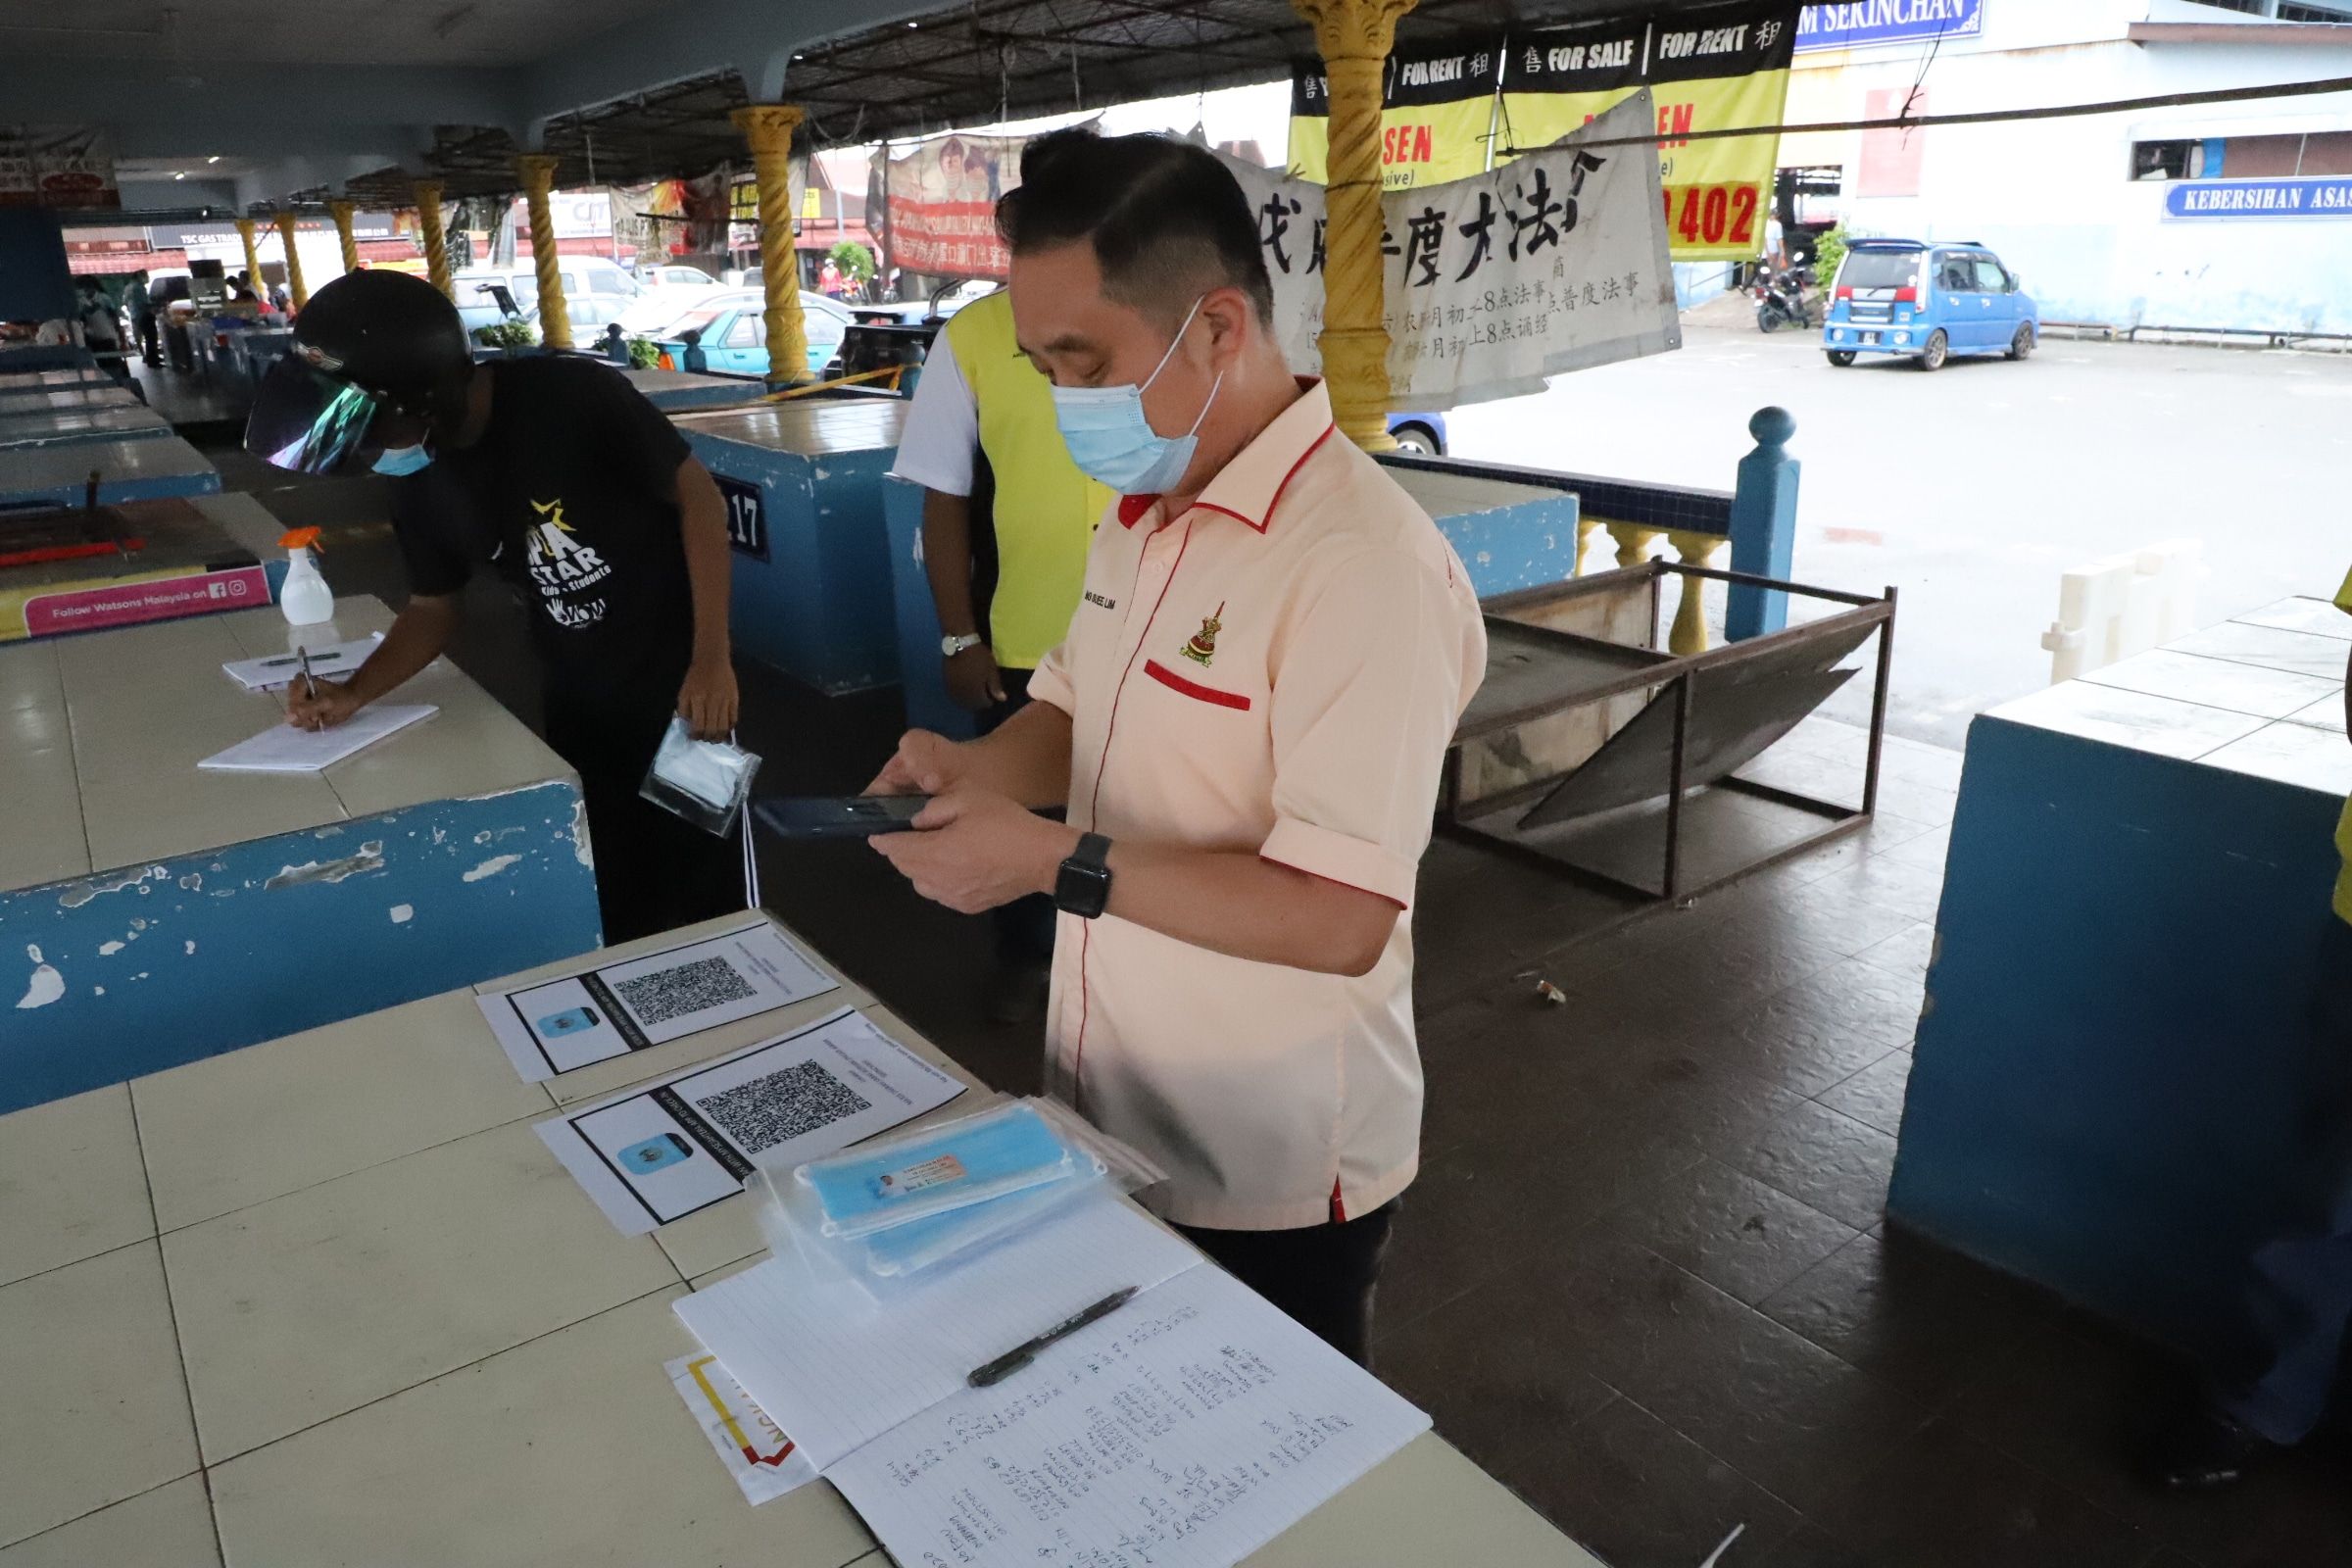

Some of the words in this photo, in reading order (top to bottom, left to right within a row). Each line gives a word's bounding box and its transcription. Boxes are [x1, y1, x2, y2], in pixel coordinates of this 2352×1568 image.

[1824, 0, 1964, 32] SEKINCHAN
[1547, 47, 1583, 72] FOR
[1586, 39, 1635, 71] SALE
[1658, 32, 1697, 60] FOR
[1694, 24, 1750, 56] RENT
[1754, 20, 1783, 51] 租
[1400, 61, 1430, 86] FOR
[1428, 55, 1466, 82] RENT
[1469, 52, 1490, 77] 租
[1381, 124, 1433, 166] SEN
[2183, 187, 2303, 211] KEBERSIHAN
[729, 493, 759, 547] 17
[568, 564, 612, 592] Students
[52, 607, 92, 619] Follow
[94, 599, 142, 613] Watsons
[144, 592, 191, 607] Malaysia
[193, 590, 207, 599] on
